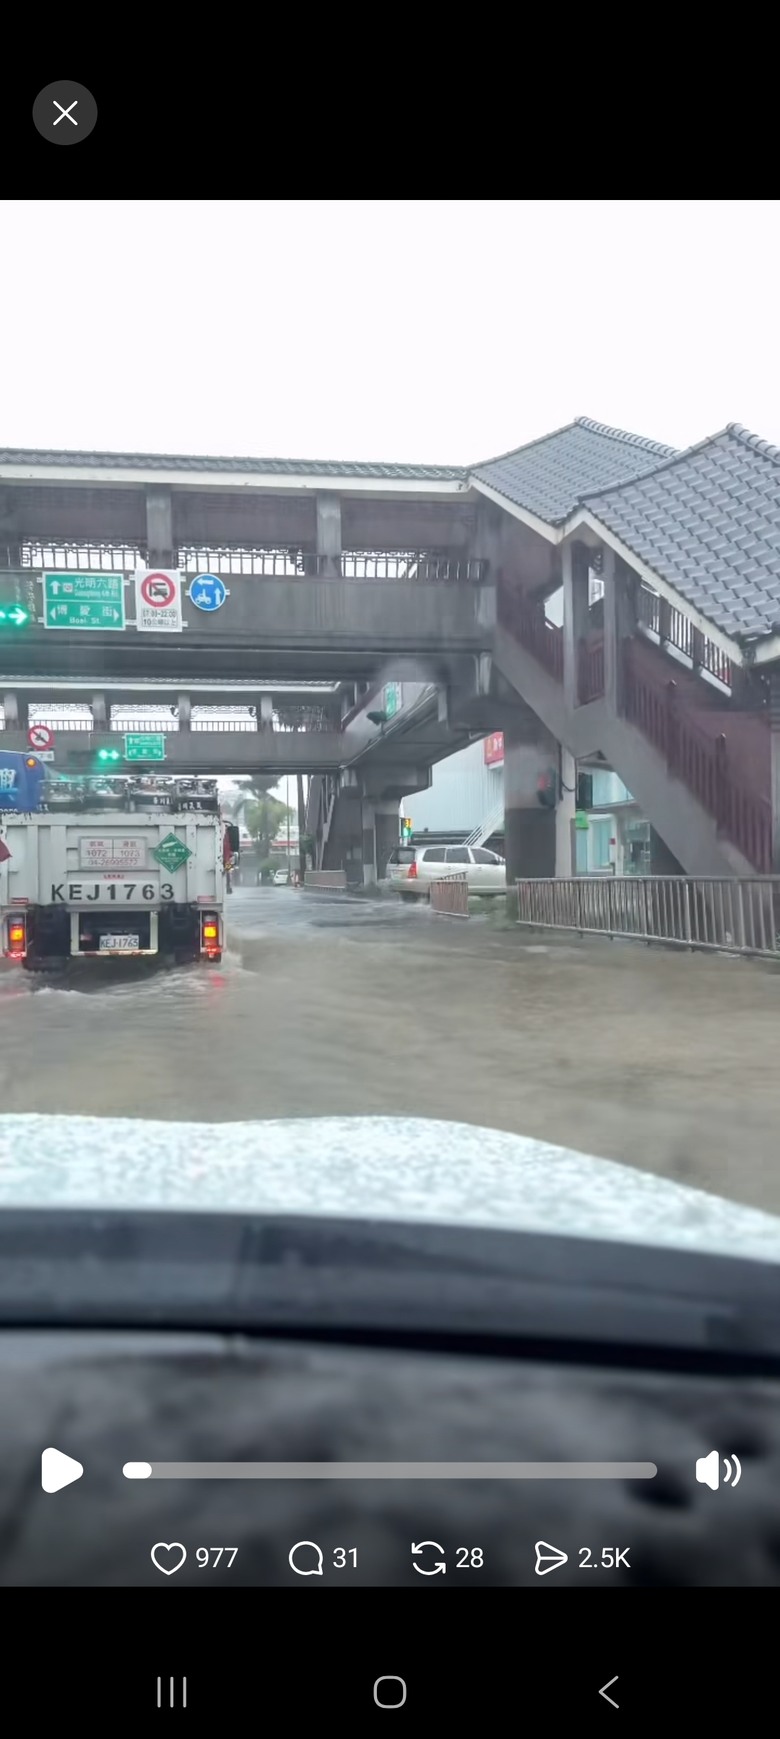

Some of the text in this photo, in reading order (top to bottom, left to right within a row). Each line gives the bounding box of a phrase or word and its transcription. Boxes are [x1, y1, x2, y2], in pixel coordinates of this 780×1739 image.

[75, 577, 119, 590] 光明六路
[51, 884, 175, 901] KEJ1763
